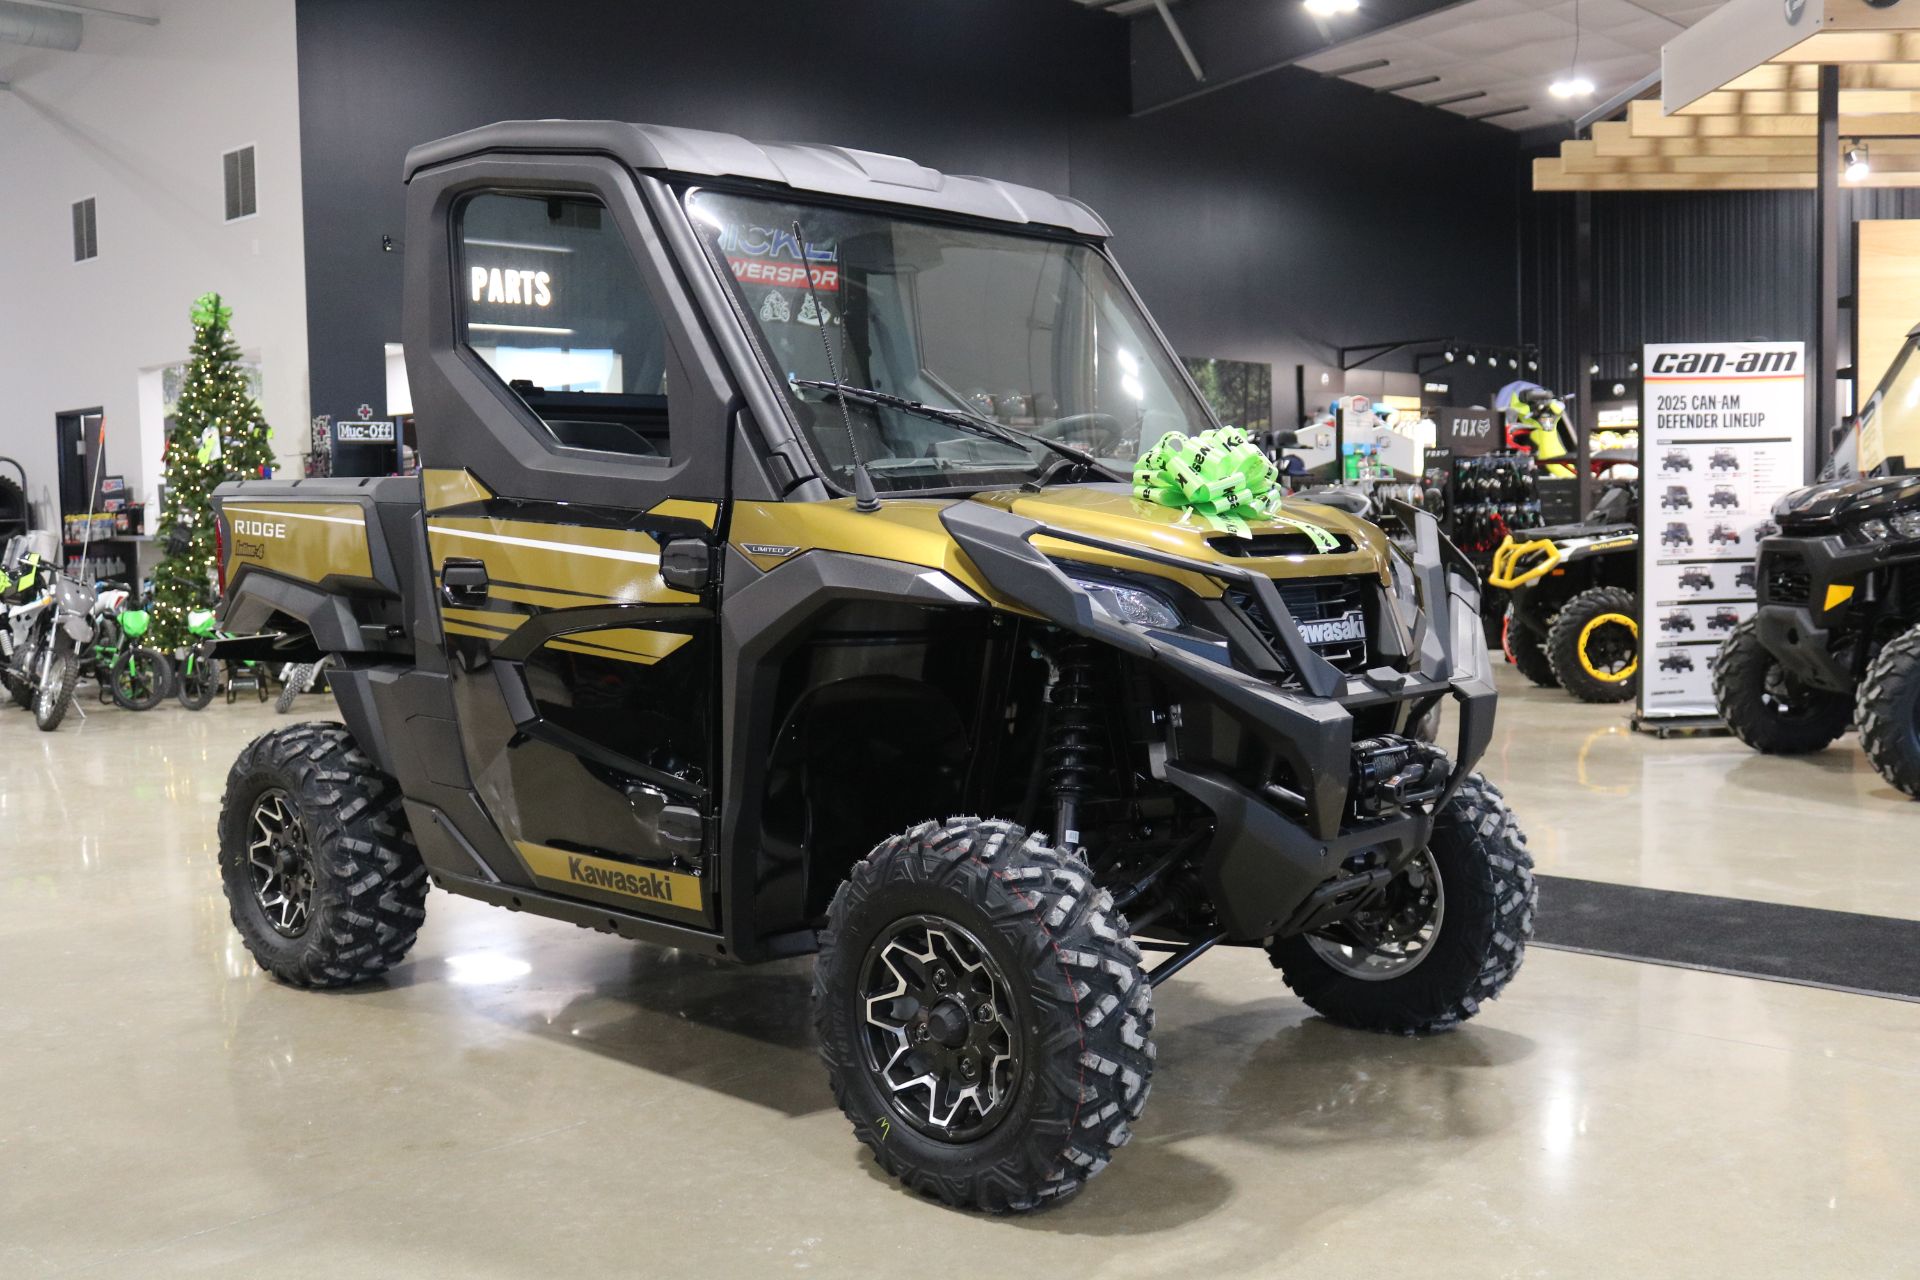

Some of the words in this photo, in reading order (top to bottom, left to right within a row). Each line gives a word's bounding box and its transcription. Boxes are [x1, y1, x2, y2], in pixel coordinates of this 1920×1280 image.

[471, 266, 551, 307] PARTS
[1652, 351, 1798, 373] can-am
[1657, 395, 1687, 411] 2025
[1691, 395, 1741, 410] CAN-AM
[1452, 418, 1476, 437] FOX
[1657, 414, 1718, 429] DEFENDER
[1723, 412, 1765, 428] LINEUP
[341, 424, 391, 438] Muc-Off
[234, 519, 286, 539] RIDGE
[752, 545, 784, 553] LIMITED
[1295, 614, 1366, 644] awasaki
[568, 855, 673, 902] Kawasaki
